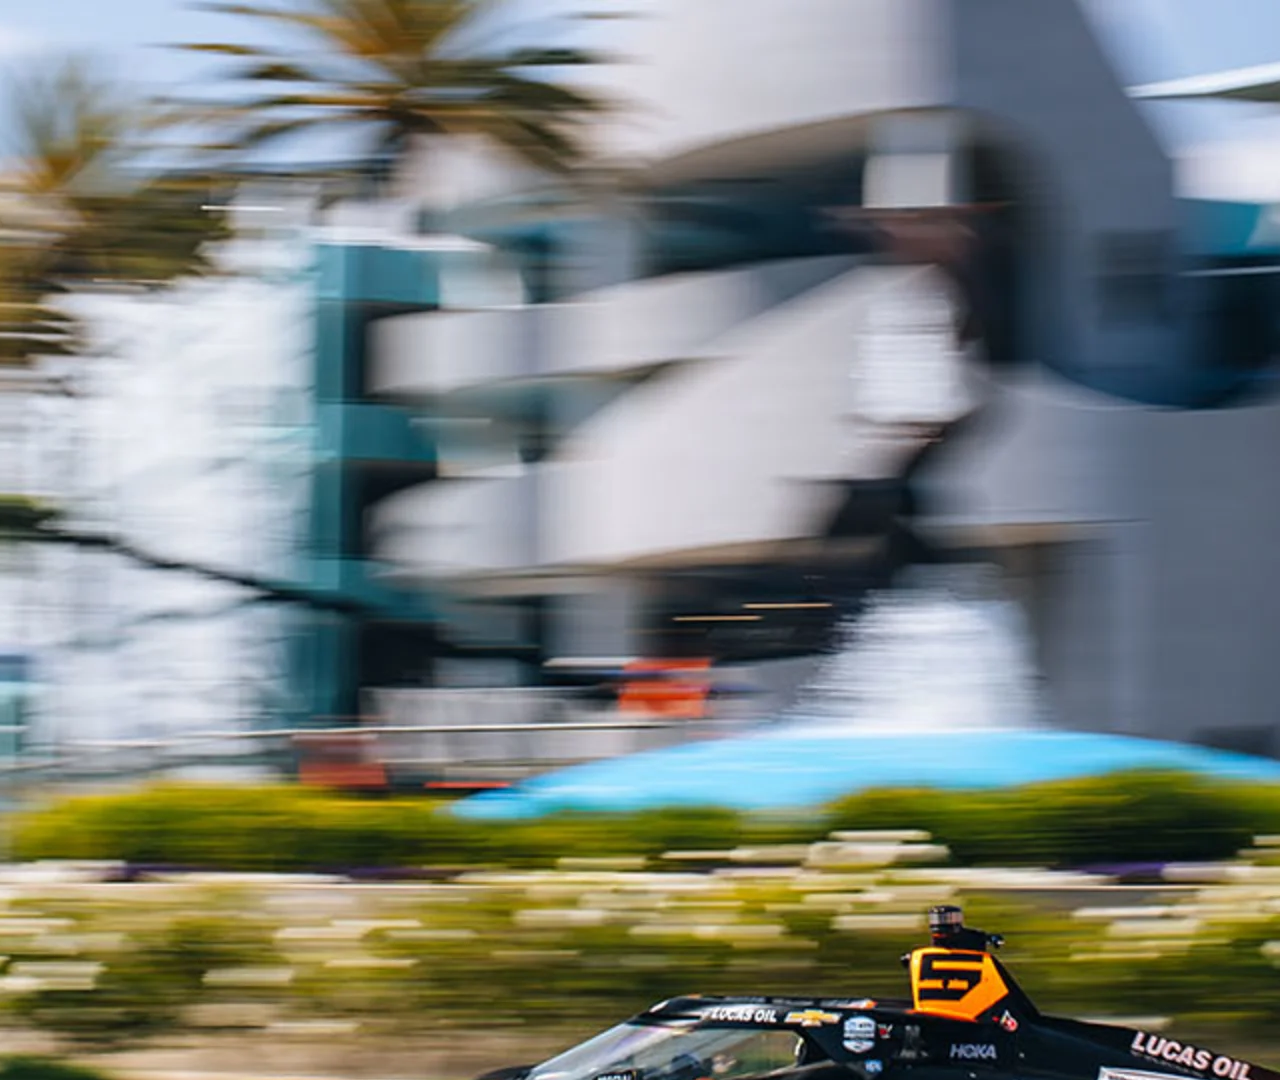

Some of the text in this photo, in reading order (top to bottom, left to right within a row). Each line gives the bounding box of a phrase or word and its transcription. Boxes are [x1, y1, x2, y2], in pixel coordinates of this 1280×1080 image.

[919, 953, 983, 1001] 5
[709, 1008, 778, 1023] LUCAS OIL
[949, 1043, 998, 1060] HOKA
[1130, 1030, 1212, 1071] LUCAS
